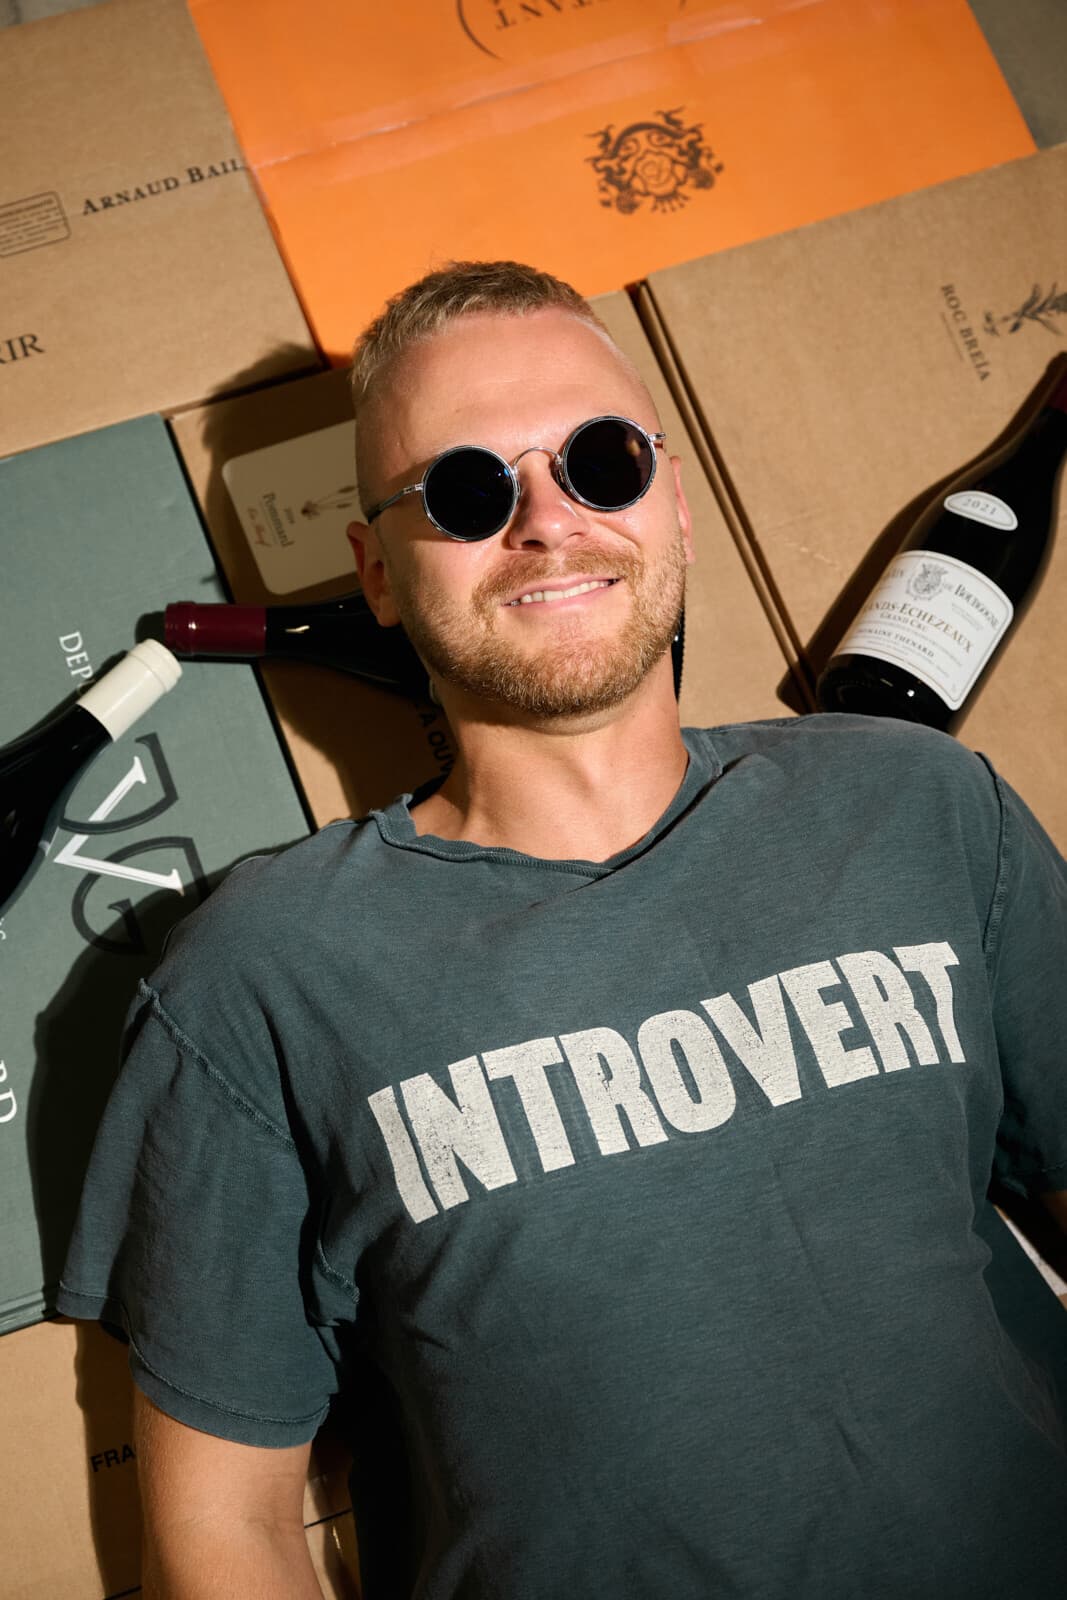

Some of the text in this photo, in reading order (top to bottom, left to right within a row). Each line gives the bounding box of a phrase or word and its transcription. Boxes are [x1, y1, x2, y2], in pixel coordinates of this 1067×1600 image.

[82, 176, 180, 216] ARNAUD
[941, 283, 968, 324] ROC
[962, 498, 996, 515] 2021
[367, 941, 966, 1224] INTROVERT
